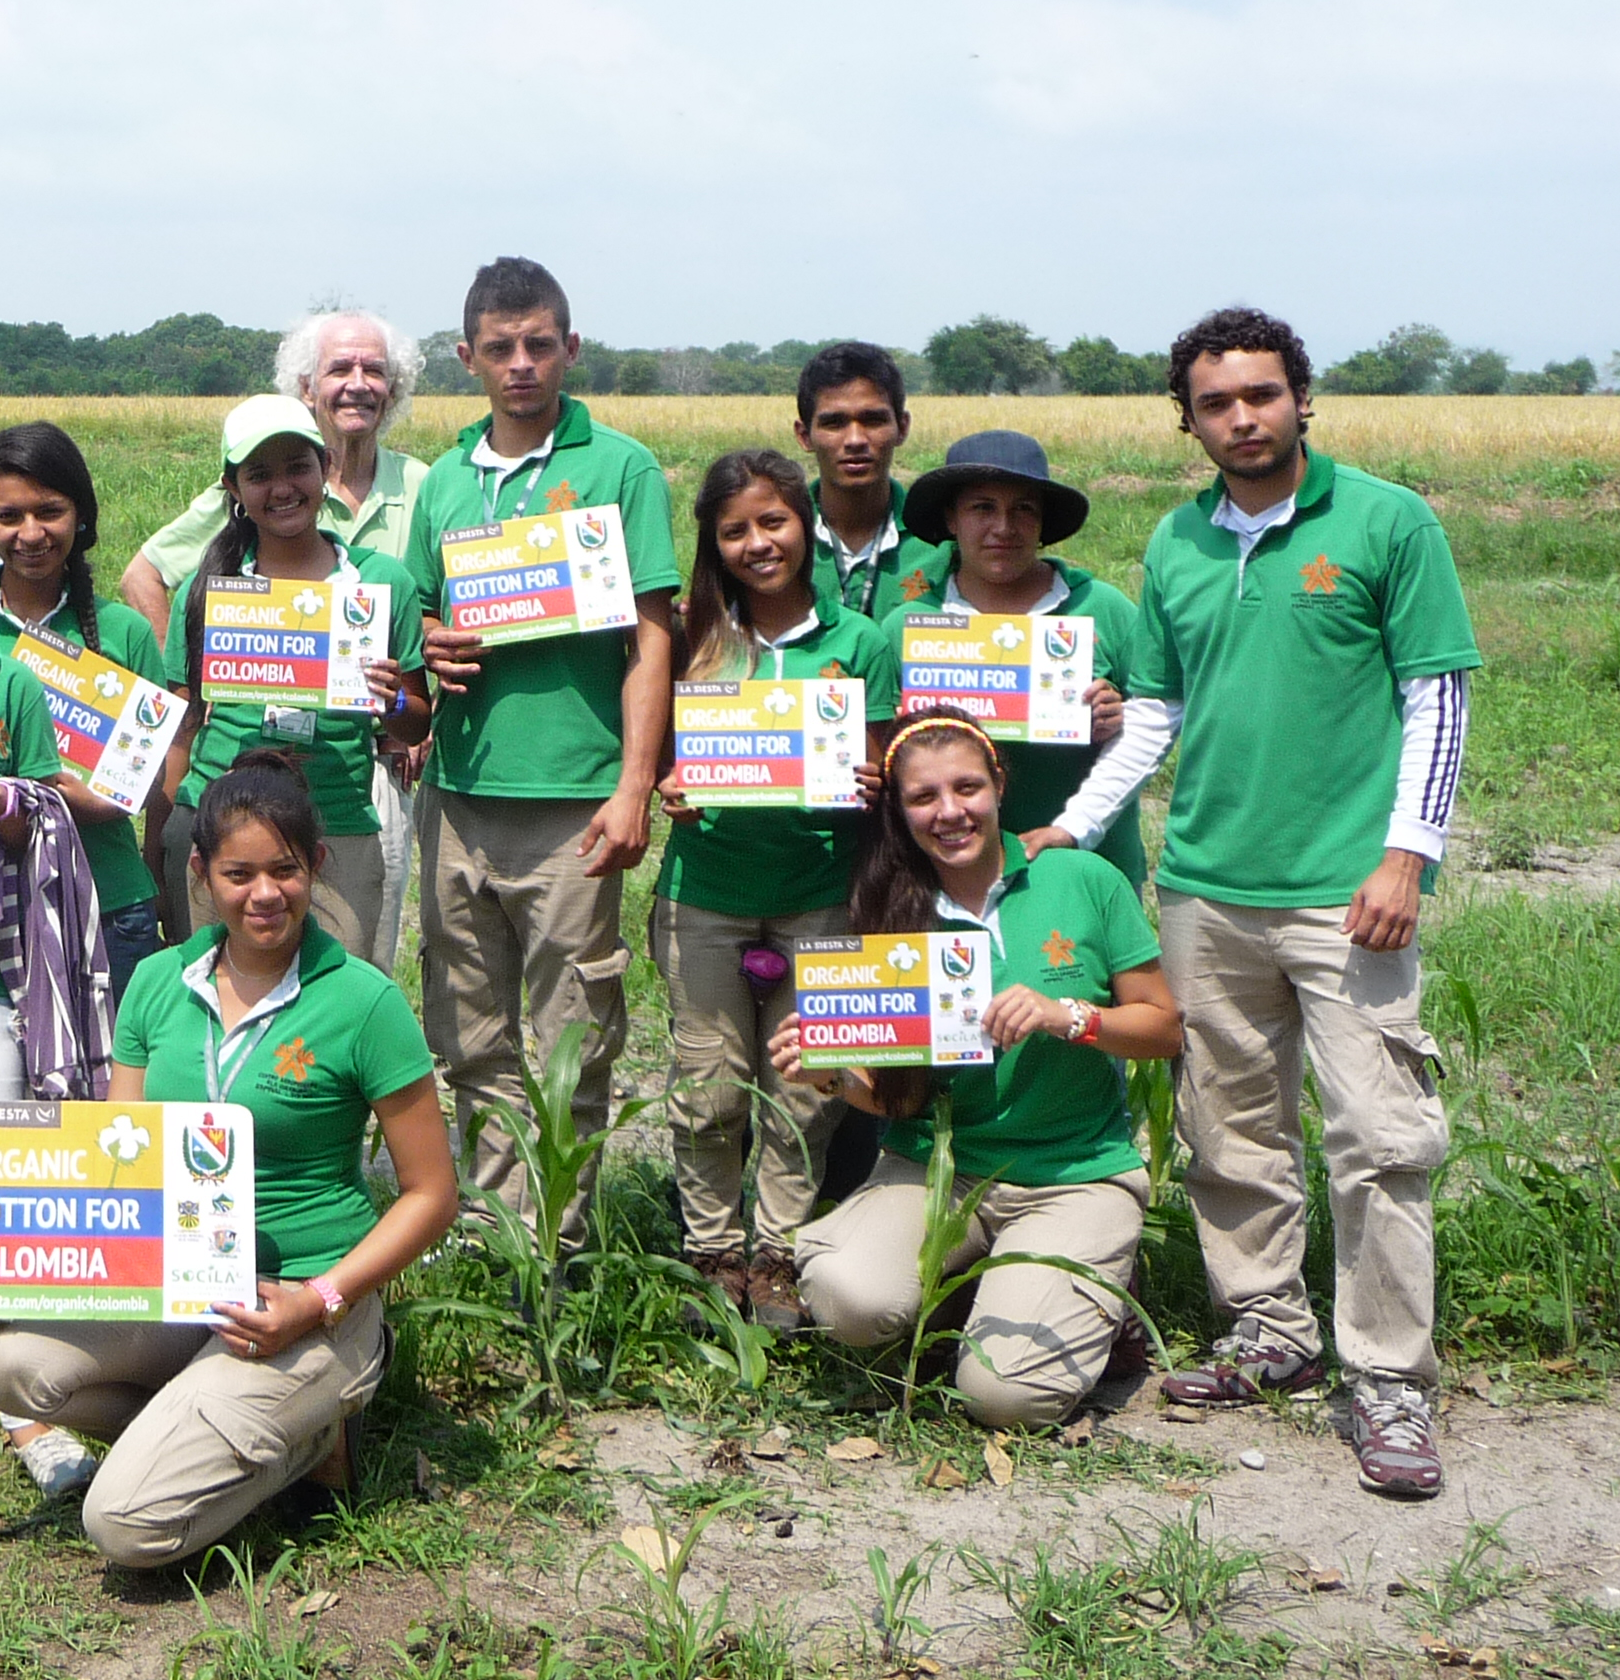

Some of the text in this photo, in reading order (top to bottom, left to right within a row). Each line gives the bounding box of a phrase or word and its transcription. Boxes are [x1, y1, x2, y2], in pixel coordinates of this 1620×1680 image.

[450, 546, 523, 572] ORGANIC
[225, 581, 252, 589] SIESTA
[454, 568, 559, 599] COTTON FOR
[212, 604, 285, 625] ORGANIC
[458, 598, 545, 626] COLOMBIA
[28, 625, 39, 635] LA
[211, 631, 316, 656] COTTON FOR
[911, 640, 985, 660] ORGANIC
[15, 646, 86, 696] ORGANIC
[210, 660, 294, 683] COLOMBIA
[910, 667, 1016, 689] COTTON FOR
[68, 706, 102, 736] FOR
[682, 709, 757, 726] ORGANIC
[683, 736, 791, 754] COTTON FOR
[683, 765, 771, 783] COLOMBIA
[814, 941, 843, 949] SIESTA
[803, 966, 881, 985] ORGANIC
[804, 994, 916, 1014] COTTON FOR
[805, 1024, 896, 1043] COLOMBIA
[87, 1199, 140, 1231] FOR
